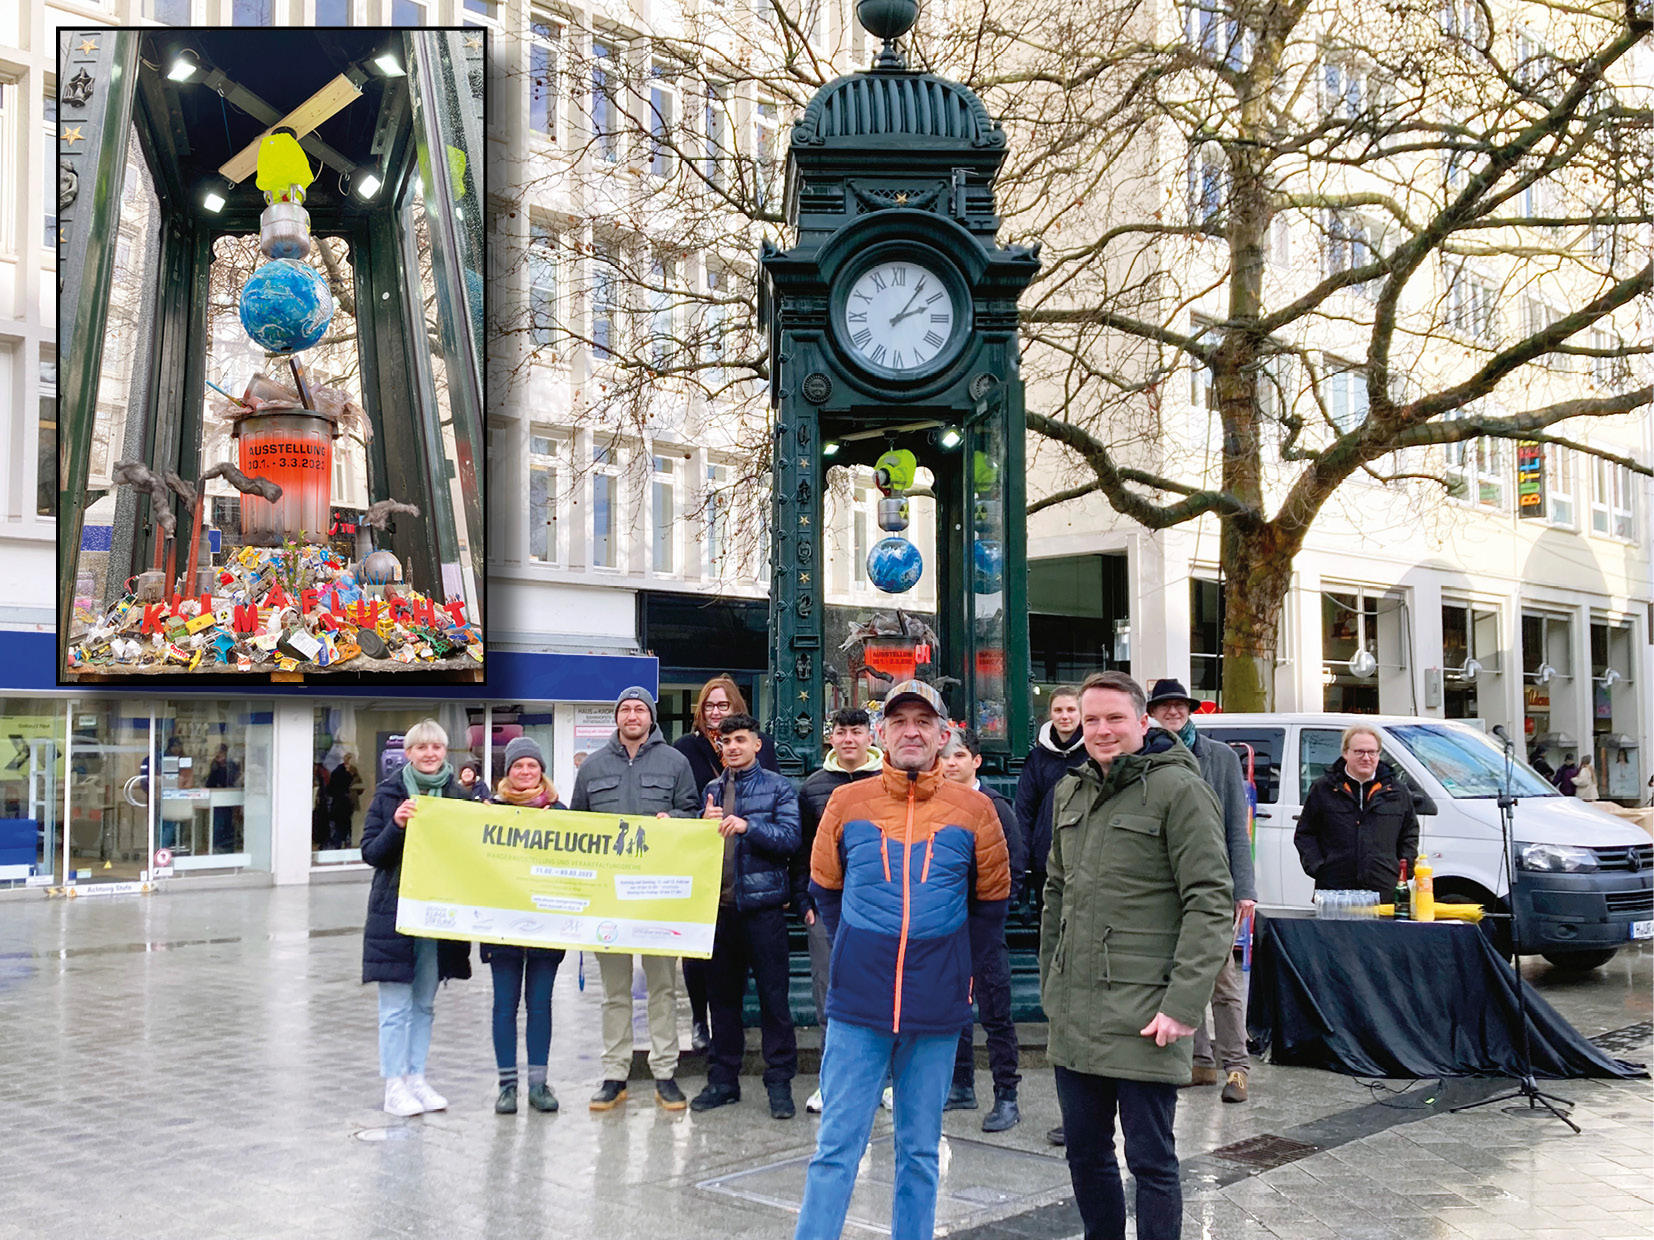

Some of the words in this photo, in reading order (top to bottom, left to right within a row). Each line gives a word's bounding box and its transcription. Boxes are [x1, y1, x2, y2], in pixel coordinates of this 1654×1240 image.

[869, 271, 887, 294] XI
[891, 267, 907, 287] XII
[853, 289, 873, 305] X
[925, 291, 944, 305] II
[848, 311, 868, 323] IX
[930, 314, 950, 324] III
[249, 444, 326, 456] AUSSTELLUNG
[140, 583, 467, 635] KLIMAFLUCHT
[483, 824, 613, 855] KLIMAFLUCHT
[87, 886, 114, 894] Achtung
